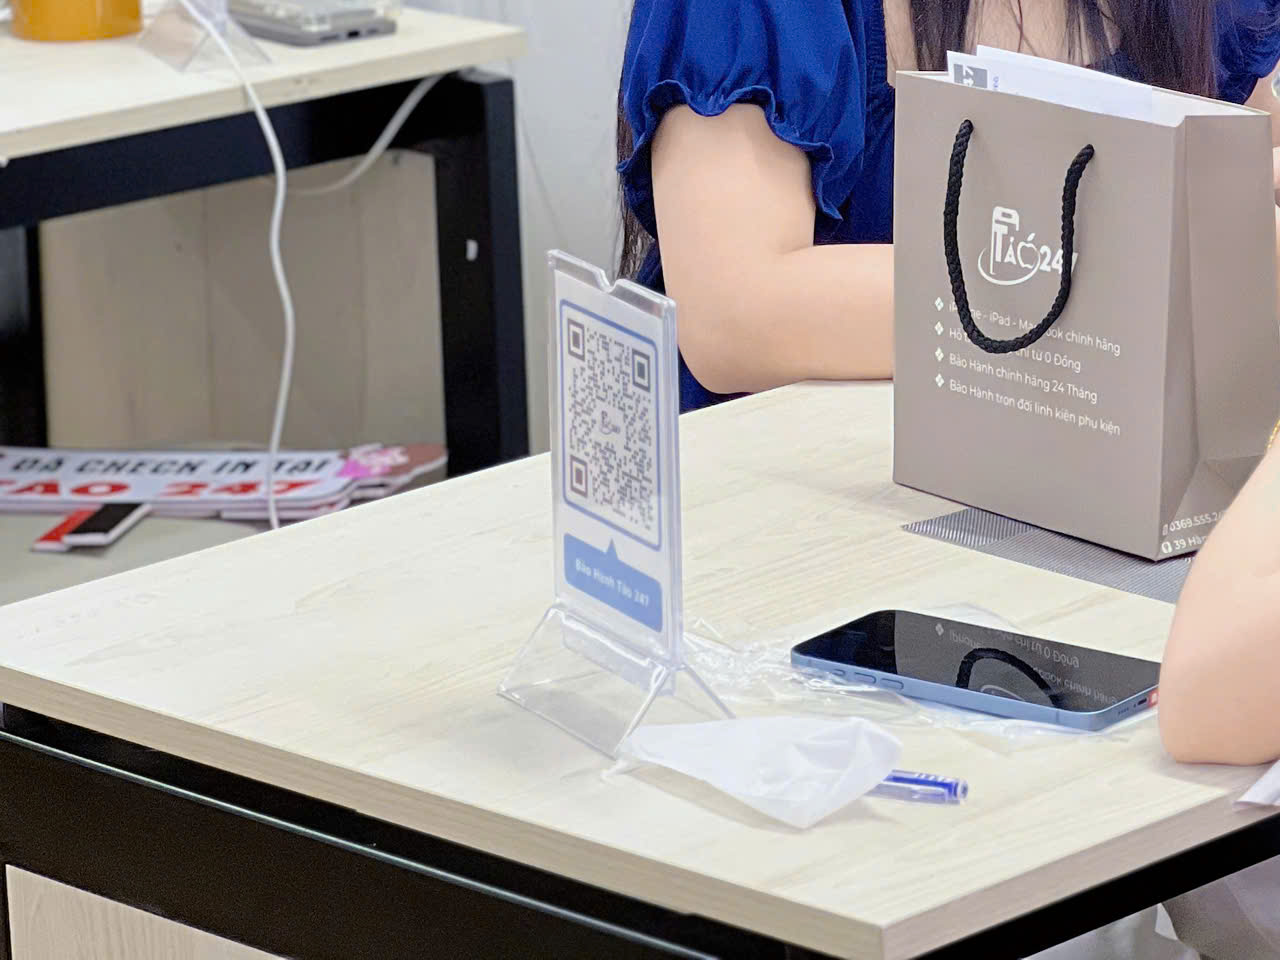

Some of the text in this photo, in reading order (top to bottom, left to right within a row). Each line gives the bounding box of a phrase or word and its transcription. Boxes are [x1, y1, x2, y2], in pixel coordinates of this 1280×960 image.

[989, 309, 1011, 327] iPad
[1051, 379, 1065, 393] 24
[212, 459, 259, 474] IN
